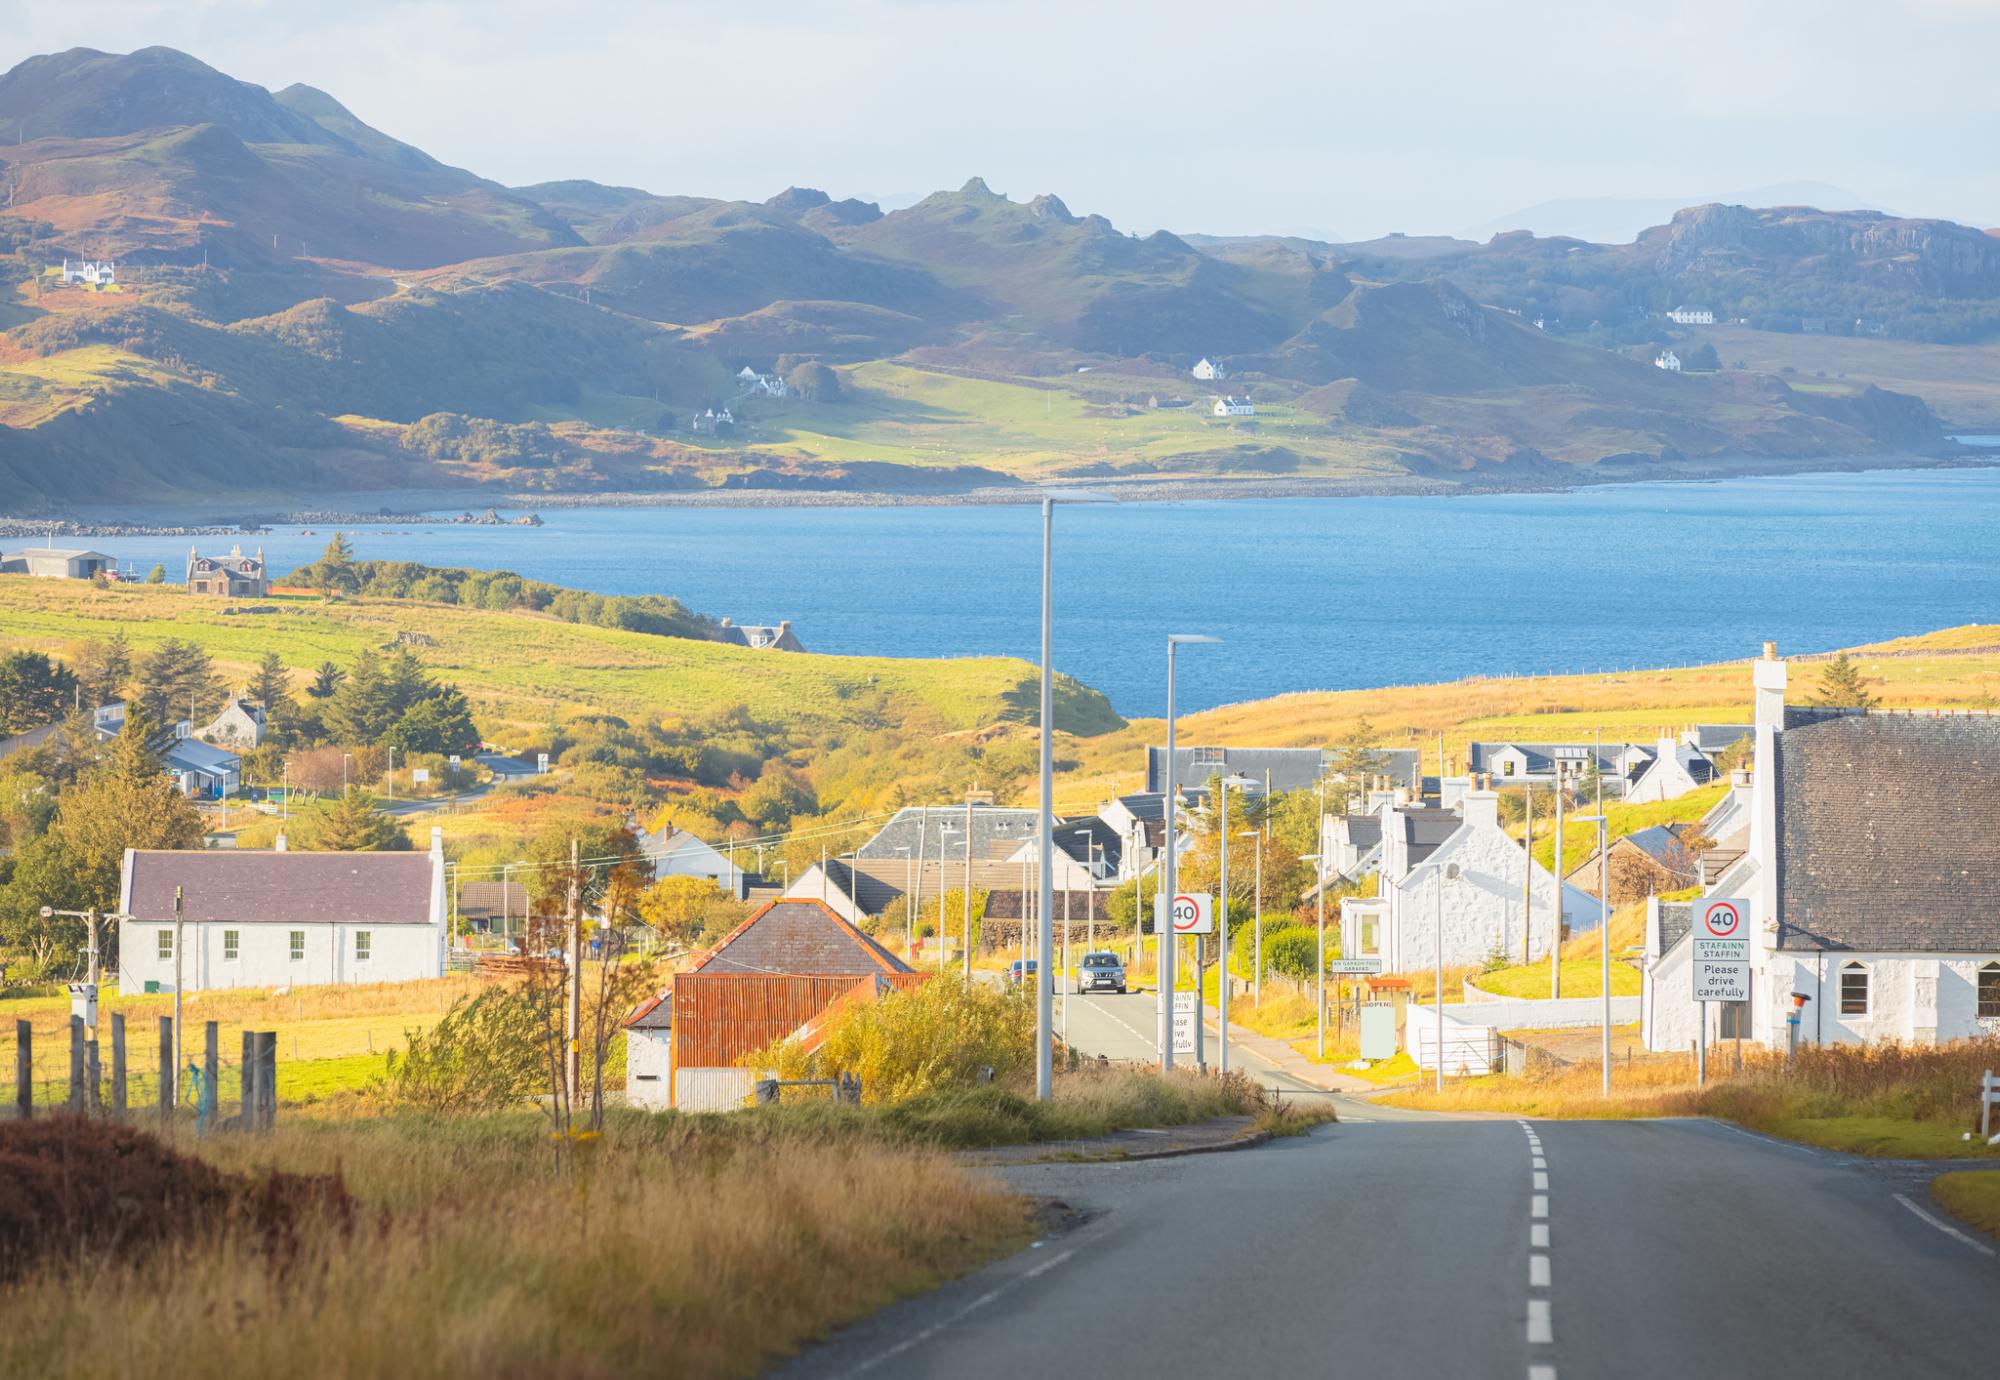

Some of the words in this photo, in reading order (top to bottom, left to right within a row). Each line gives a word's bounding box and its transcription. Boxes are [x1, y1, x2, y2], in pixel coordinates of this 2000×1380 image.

[1173, 906, 1195, 920] 40
[1710, 912, 1734, 926] 40
[1699, 942, 1745, 950] STAFAINN
[1703, 950, 1741, 958] STAFFIN
[1704, 964, 1739, 974] Please
[1708, 976, 1735, 985] drive
[1697, 987, 1745, 998] carefully
